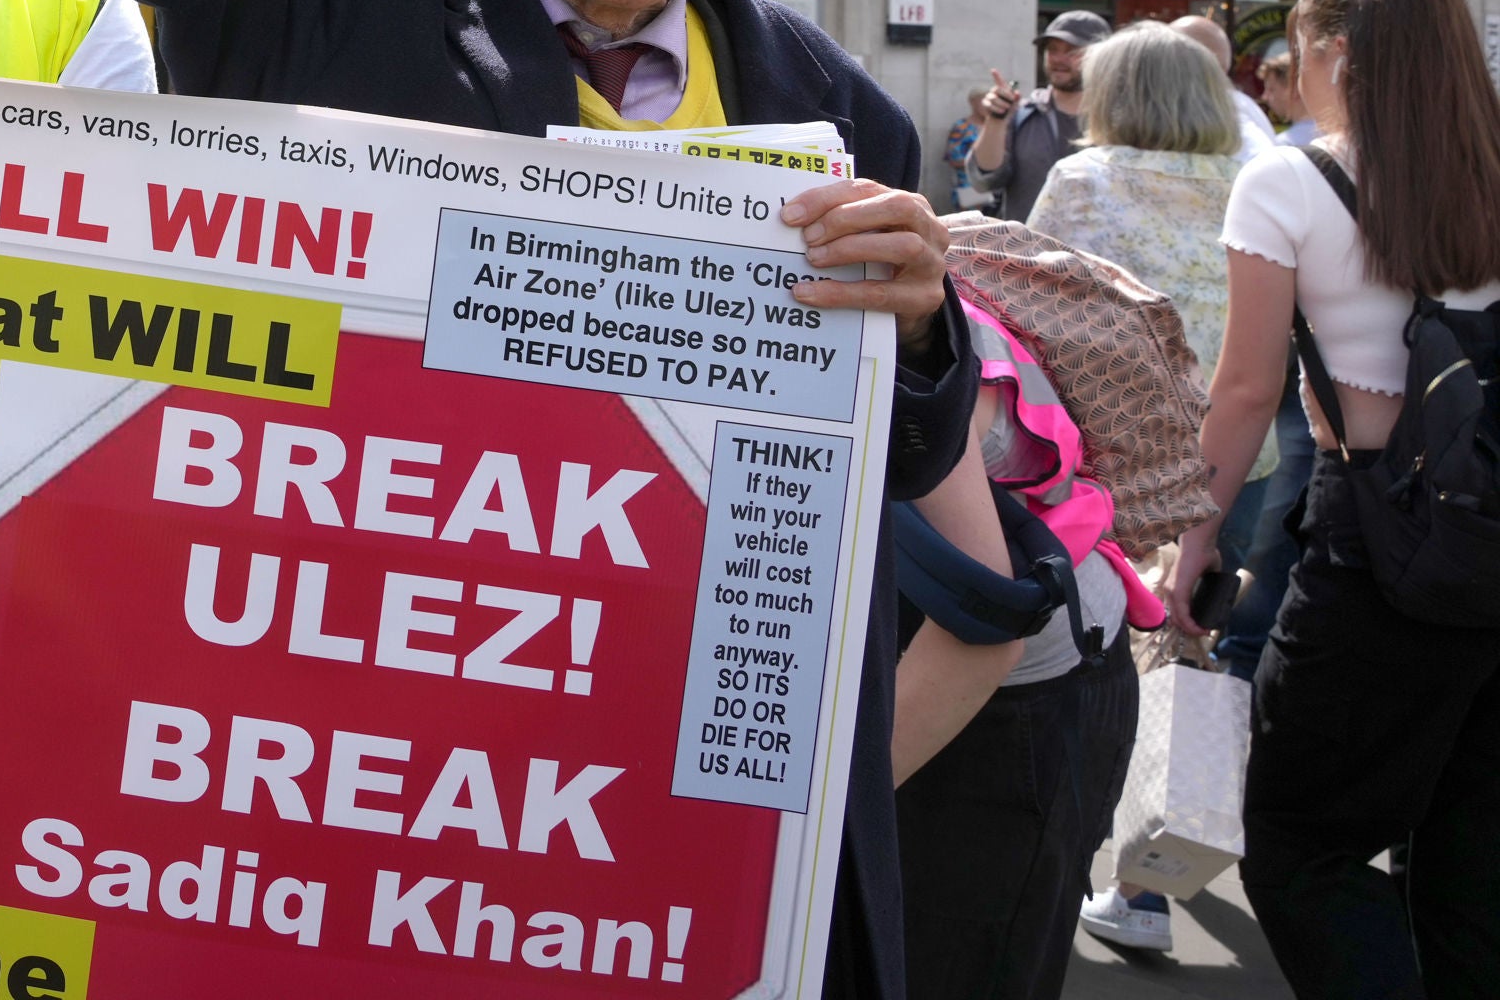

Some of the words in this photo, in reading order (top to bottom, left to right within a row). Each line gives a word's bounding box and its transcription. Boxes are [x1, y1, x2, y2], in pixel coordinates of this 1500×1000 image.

[1, 104, 71, 135] cars,
[82, 114, 159, 146] vans,
[170, 119, 267, 161] lorries,
[279, 135, 356, 173] taxis,
[368, 144, 508, 192] Windows,
[519, 164, 645, 205] SHOPS!
[656, 184, 733, 217] Unite
[742, 195, 770, 221] to
[147, 182, 373, 280] WIN!
[469, 226, 496, 252] In
[505, 231, 680, 276] Birmingham
[690, 255, 736, 282] the
[473, 263, 518, 291] Air
[615, 281, 675, 312] (like
[684, 289, 756, 325] Ulez)
[763, 305, 822, 330] was
[88, 294, 316, 391] WILL
[452, 296, 575, 336] dropped
[583, 306, 704, 350] because
[712, 331, 747, 355] so
[756, 337, 837, 372] many
[502, 337, 649, 378] REFUSED
[657, 356, 698, 386] TO
[707, 363, 777, 396] PAY.
[731, 437, 834, 473] THINK!
[152, 405, 660, 569] BREAK
[746, 472, 762, 493] If
[766, 476, 812, 504] they
[730, 501, 766, 523] win
[772, 508, 822, 530] your
[734, 531, 809, 556] vehicle
[725, 558, 761, 579] will
[766, 564, 812, 586] cost
[714, 584, 749, 606] too
[755, 591, 813, 614] much
[184, 542, 603, 697] ULEZ!
[729, 614, 750, 635] to
[756, 620, 791, 640] run
[713, 644, 799, 673] anyway.
[717, 668, 749, 691] SO
[755, 672, 790, 696] ITS
[713, 696, 747, 719] DO
[752, 701, 787, 725] OR
[701, 723, 738, 747] DIE
[744, 728, 791, 754] FOR
[119, 700, 627, 863] BREAK
[699, 752, 730, 775] US
[734, 757, 786, 783] ALL!
[14, 817, 327, 948] Sadiq
[368, 869, 694, 984] Khan!
